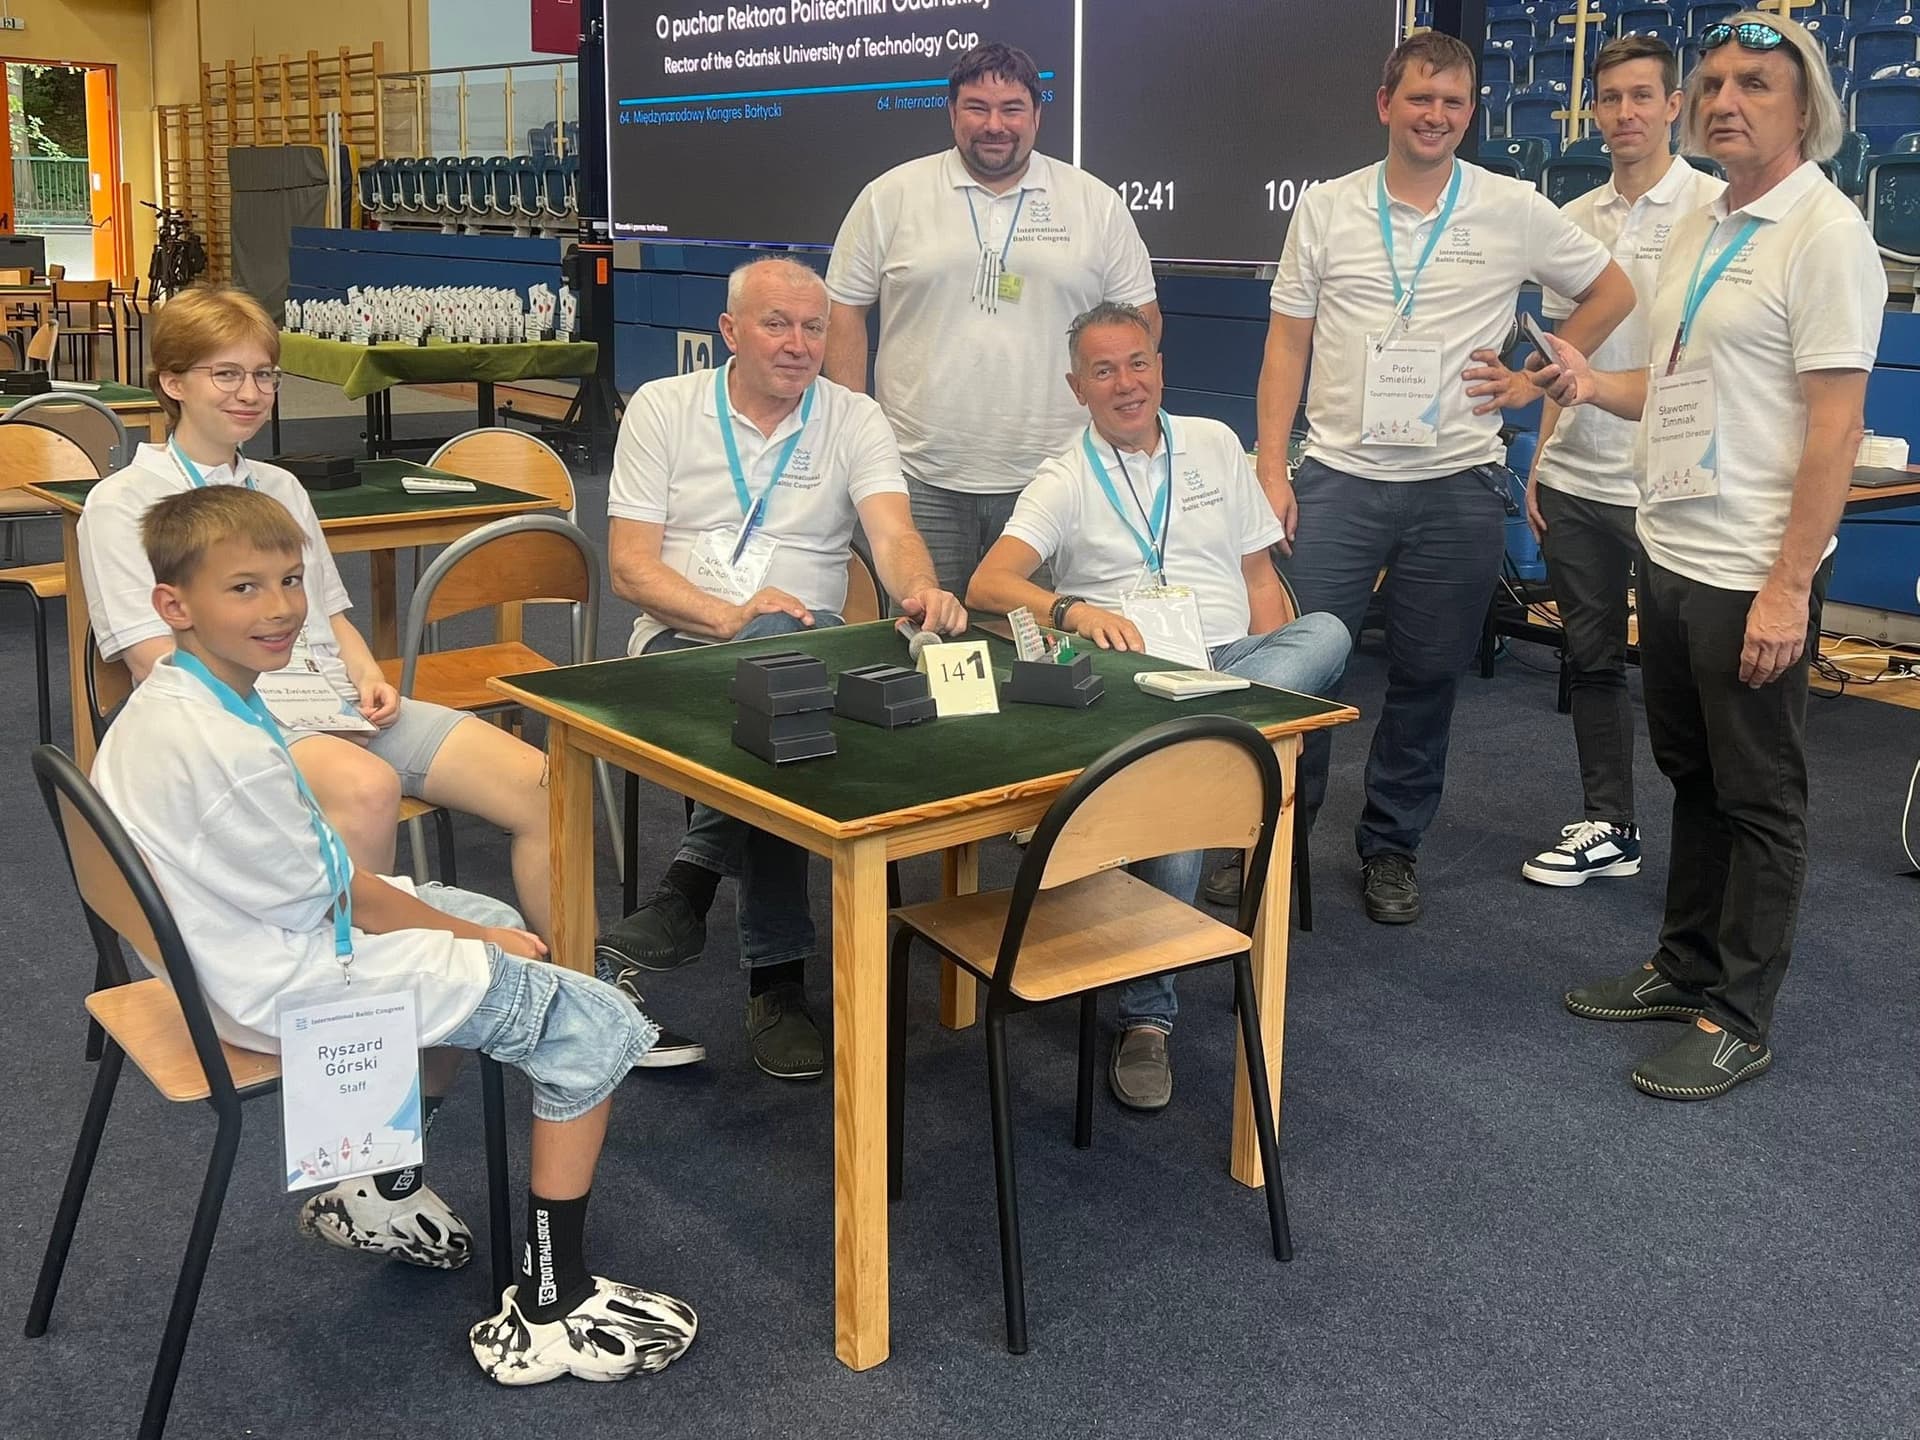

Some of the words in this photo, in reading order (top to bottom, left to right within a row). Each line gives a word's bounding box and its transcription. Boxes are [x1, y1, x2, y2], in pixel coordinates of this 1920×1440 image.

[655, 15, 670, 39] O
[672, 10, 725, 42] puchar
[727, 4, 786, 31] Rektora
[664, 56, 700, 74] Rector
[700, 52, 714, 71] of
[714, 51, 733, 70] the
[735, 46, 781, 68] Gdańsk
[782, 41, 844, 65] University
[846, 37, 861, 59] of
[862, 32, 943, 58] Technology
[945, 29, 979, 51] Cup
[876, 96, 892, 111] 64.
[633, 107, 705, 126] Międzynarodowy
[705, 105, 743, 123] Kongres
[744, 102, 783, 121] Bałtycki
[1117, 181, 1176, 211] 12:41
[1016, 225, 1067, 233] International
[1439, 249, 1483, 257] International
[1392, 363, 1414, 374] Piotr
[1658, 401, 1699, 416] Sławomir
[1662, 414, 1696, 428] Zimniak
[311, 1012, 354, 1025] International
[355, 1010, 374, 1018] Baltic
[375, 1005, 405, 1014] Congress
[318, 1037, 383, 1060] Ryszard
[325, 1056, 378, 1077] Górski
[339, 1081, 367, 1094] Staff
